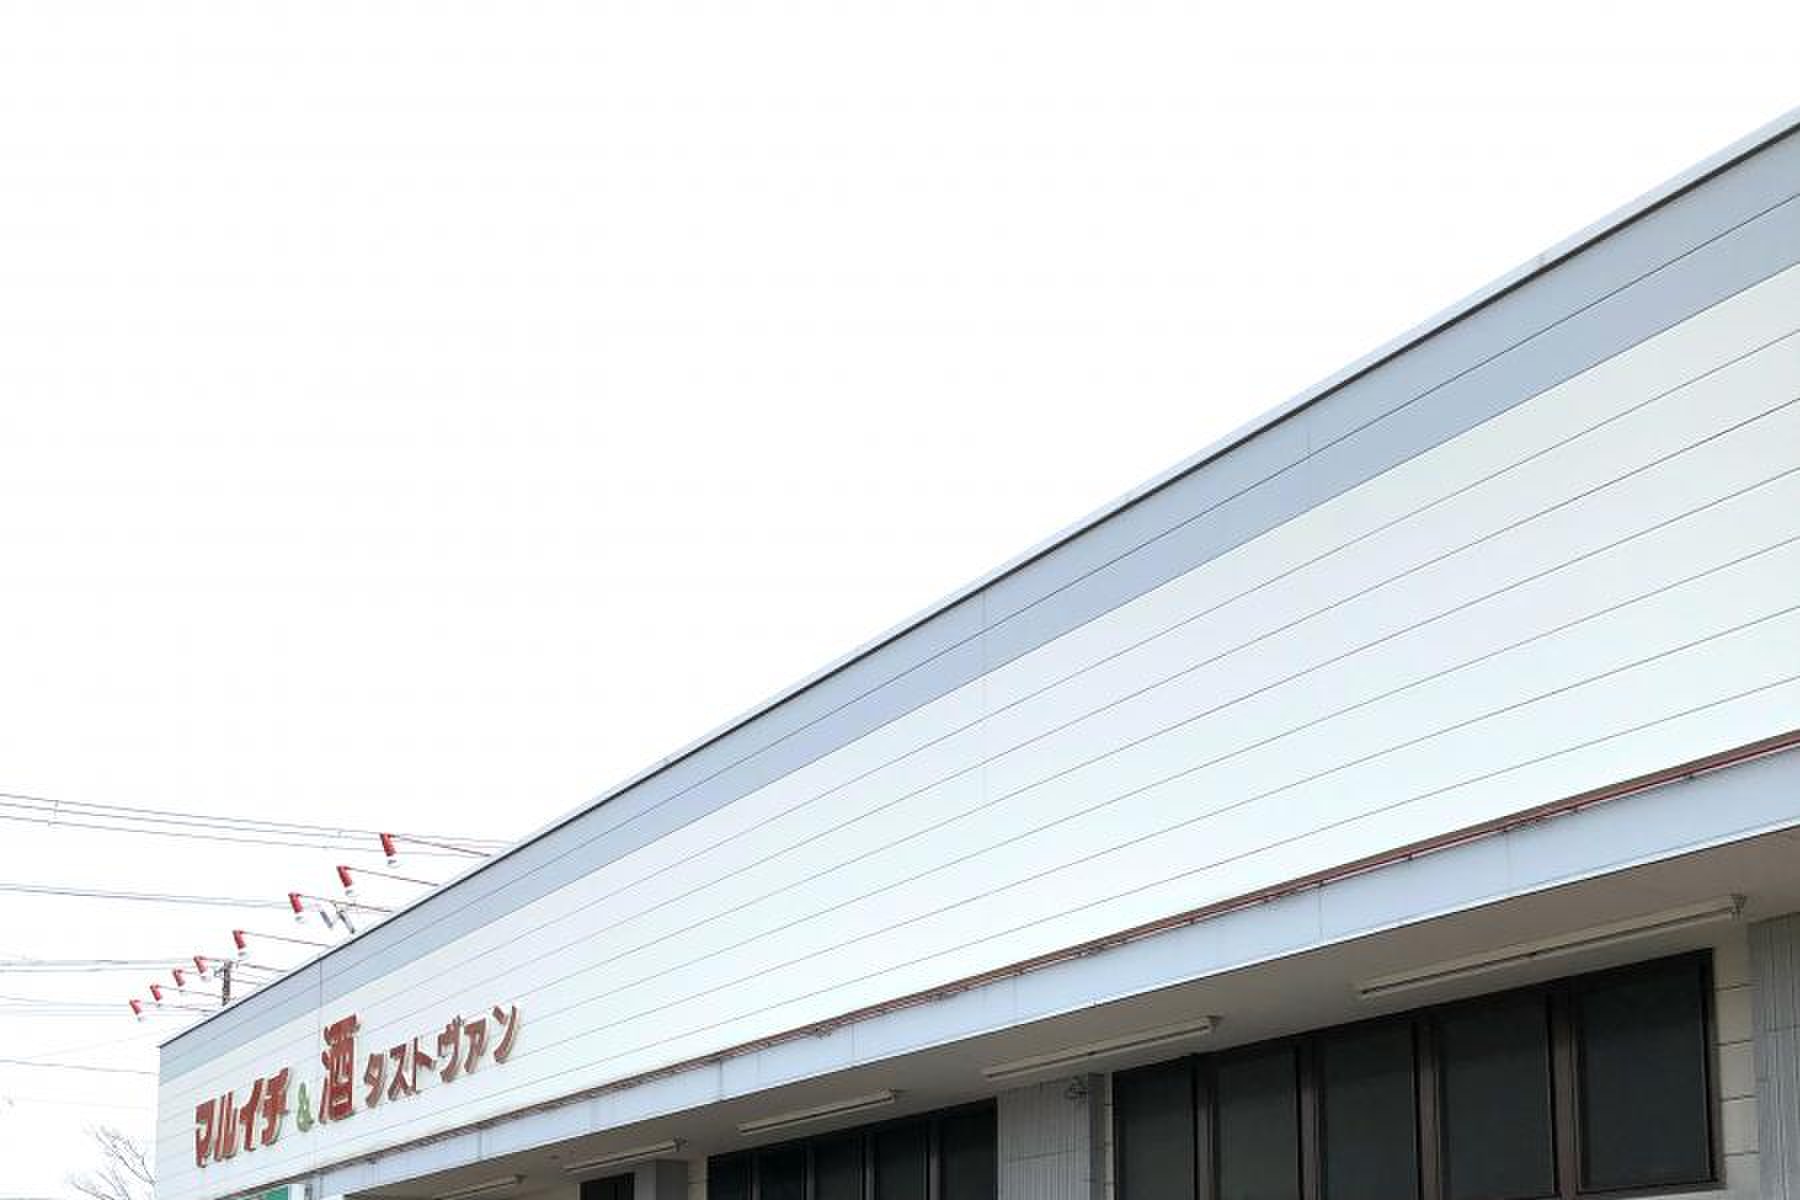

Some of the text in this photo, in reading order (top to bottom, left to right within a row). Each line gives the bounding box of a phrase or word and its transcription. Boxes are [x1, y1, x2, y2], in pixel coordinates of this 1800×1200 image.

[194, 1004, 521, 1168] マルイチ & 酒 タストヴァン
